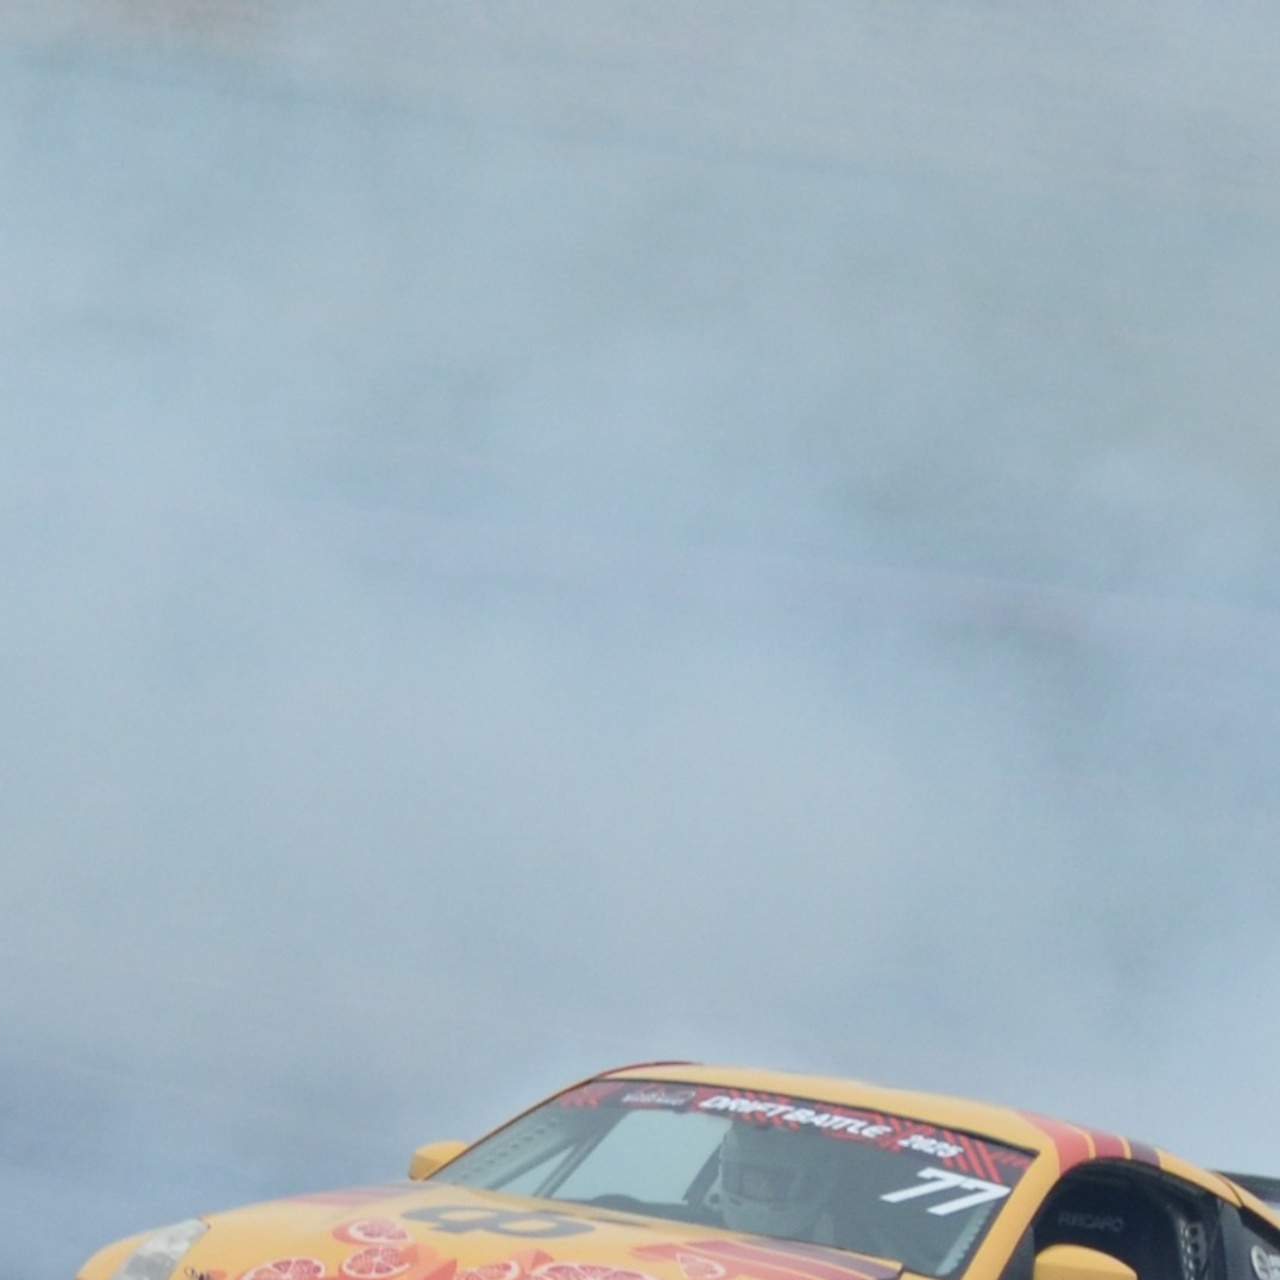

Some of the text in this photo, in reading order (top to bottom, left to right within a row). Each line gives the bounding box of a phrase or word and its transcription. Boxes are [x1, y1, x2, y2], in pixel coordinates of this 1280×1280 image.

[698, 1095, 795, 1118] DRIFT
[781, 1108, 893, 1138] BATTLE
[880, 1166, 1012, 1216] 77
